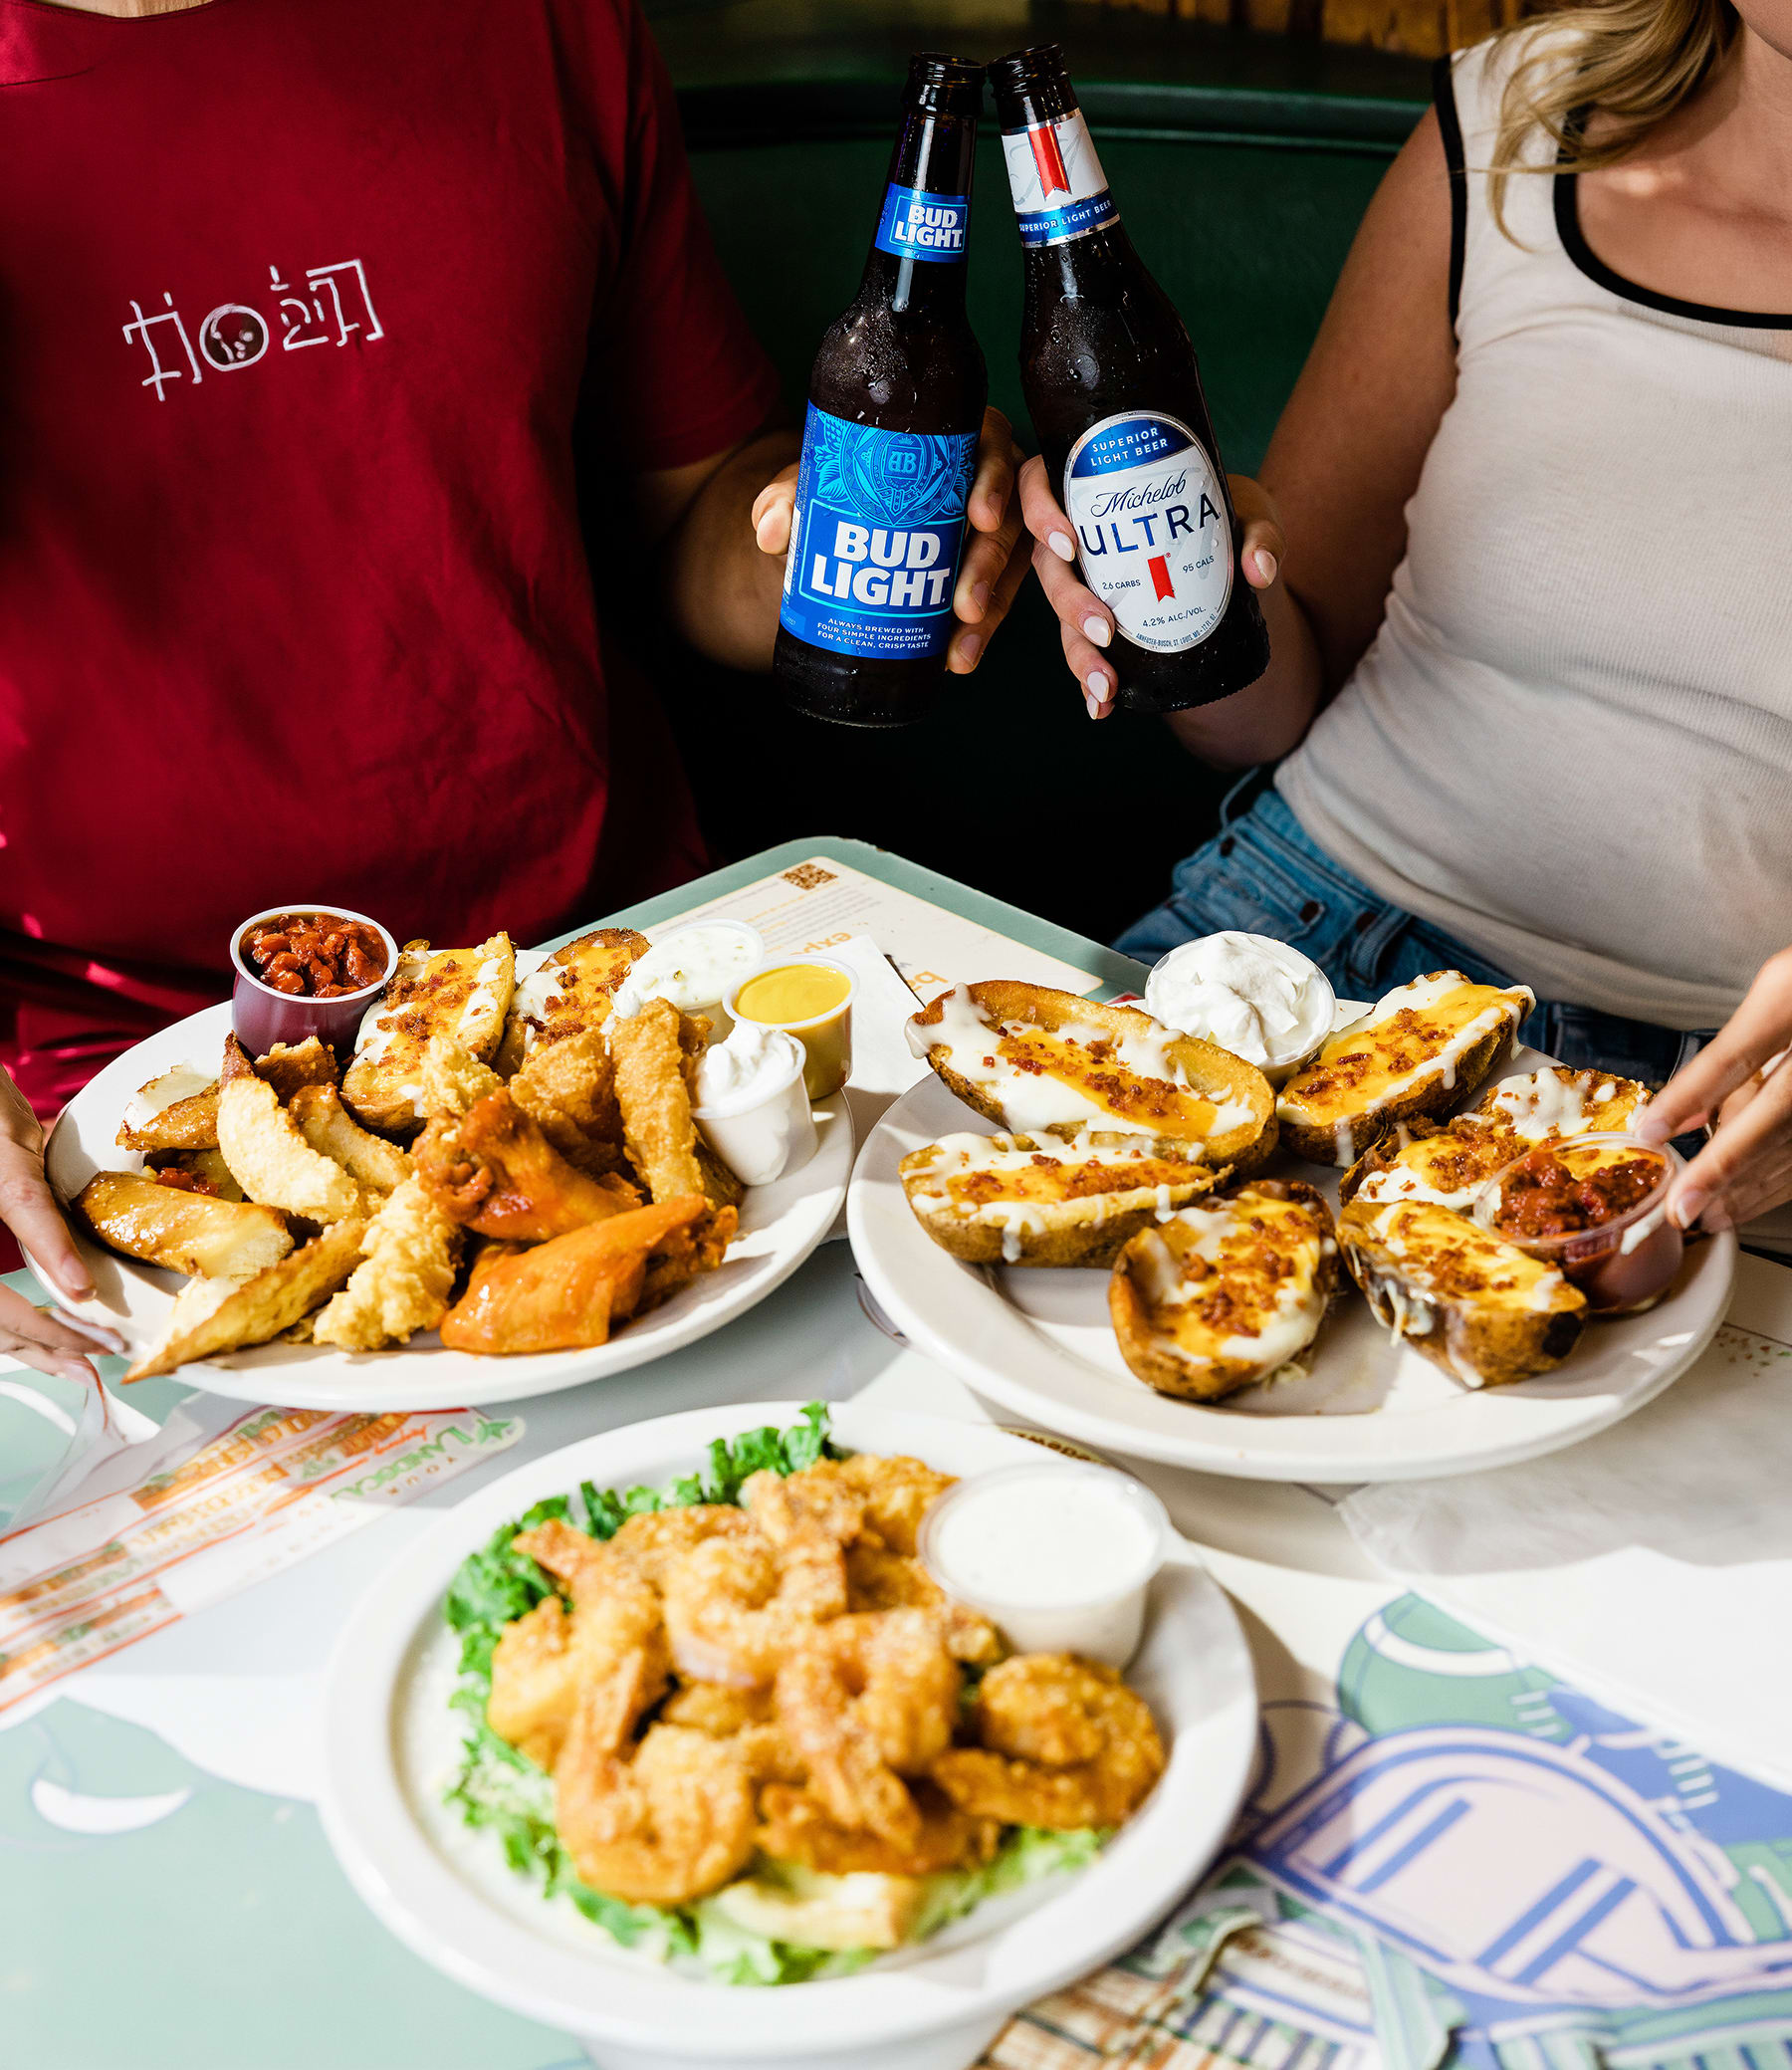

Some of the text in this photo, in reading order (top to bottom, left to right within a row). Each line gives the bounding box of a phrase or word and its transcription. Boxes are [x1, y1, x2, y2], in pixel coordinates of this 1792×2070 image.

[908, 204, 958, 228] BUD
[1062, 209, 1091, 225] LIGHT
[1094, 199, 1112, 214] BEER
[895, 221, 963, 247] LIGHT
[1091, 438, 1169, 467] LIGHT BEER
[1092, 427, 1159, 453] SUPERIOR
[1090, 469, 1188, 518] Michelob
[1079, 492, 1221, 557] ULTRA
[833, 521, 941, 569] BUD
[1183, 556, 1215, 574] 95 CALS
[810, 554, 951, 606] LIGHT
[1102, 579, 1141, 590] 2.6 CARBS
[828, 617, 862, 630] ALWAYS
[1142, 606, 1207, 626] 4.2% ALC./VOL.
[817, 622, 839, 633] FOUR
[841, 629, 875, 639] SIMPLE
[817, 630, 834, 640] FOR
[843, 637, 876, 648] CLEAN,
